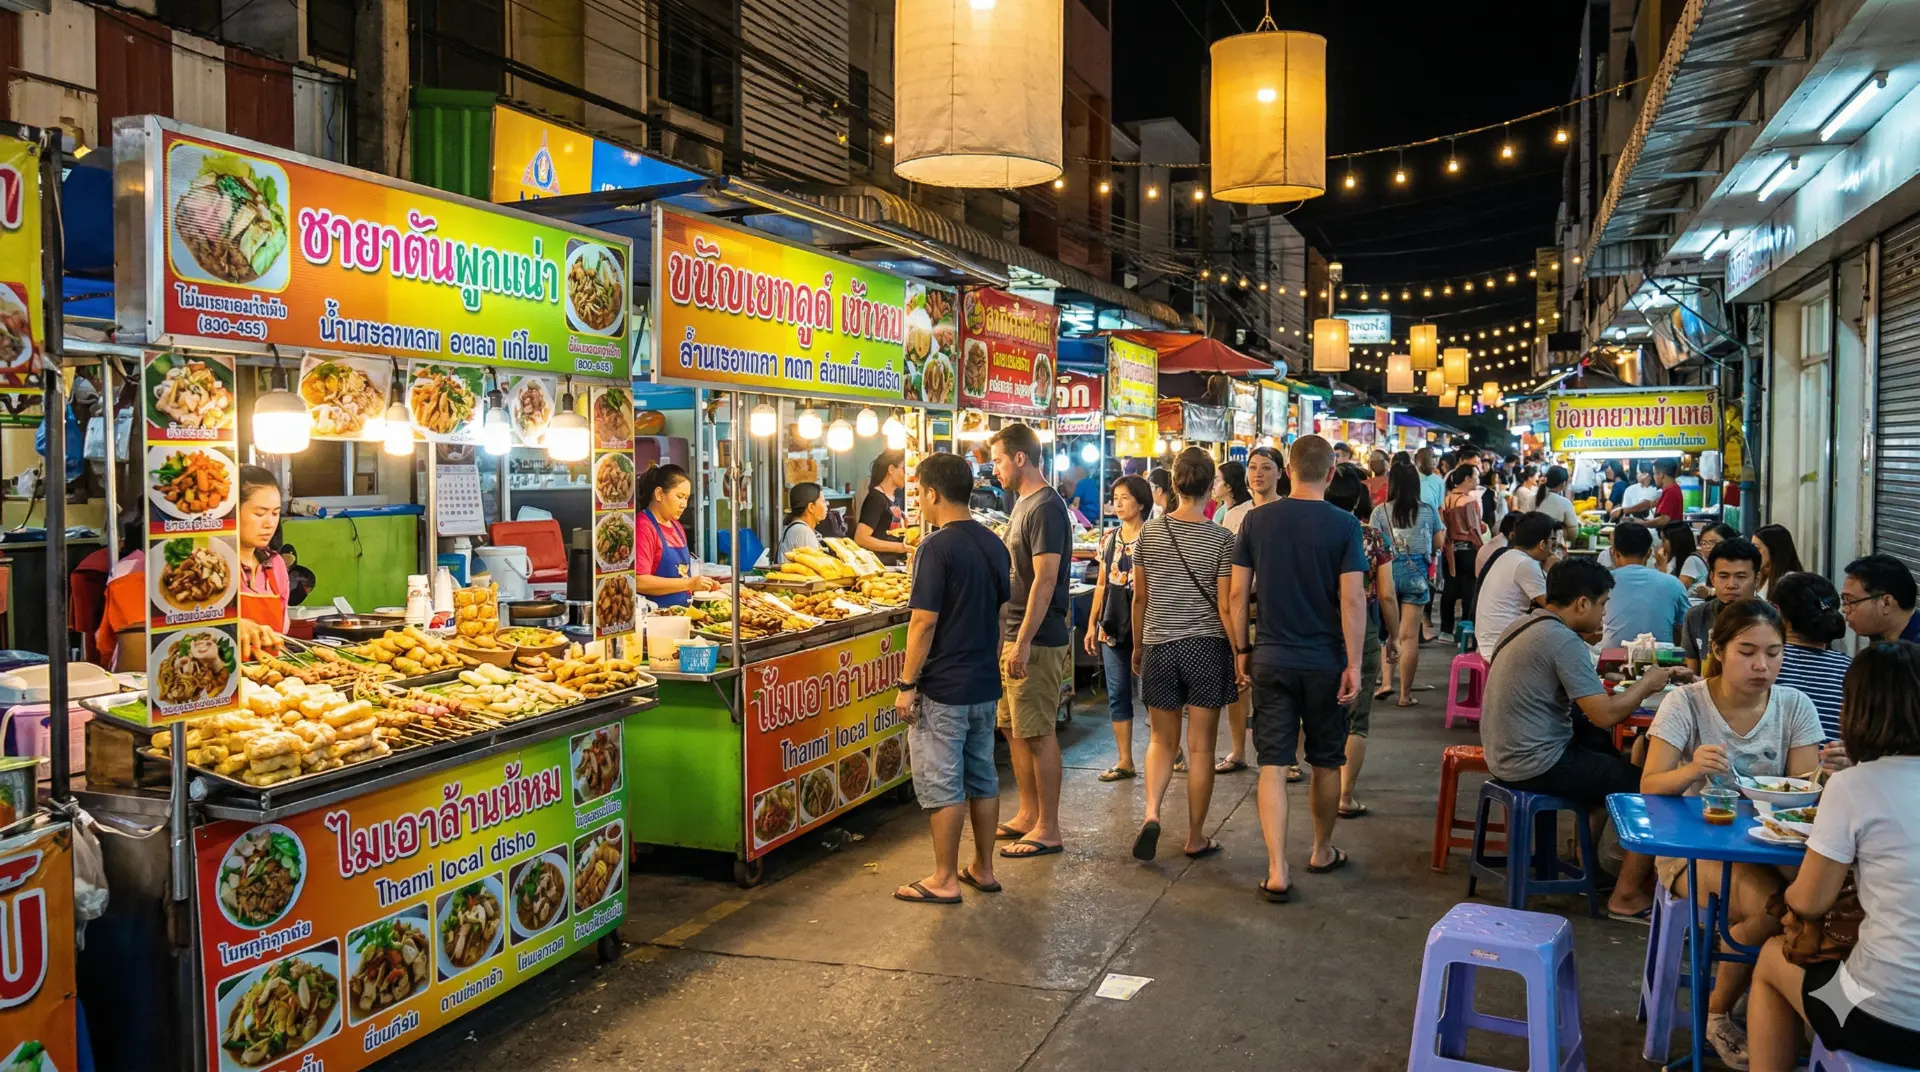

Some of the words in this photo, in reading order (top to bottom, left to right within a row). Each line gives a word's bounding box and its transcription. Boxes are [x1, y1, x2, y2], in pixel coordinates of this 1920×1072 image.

[835, 713, 868, 749] local
[375, 865, 434, 906] Thami
[441, 846, 483, 882] local
[491, 832, 536, 862] disho
